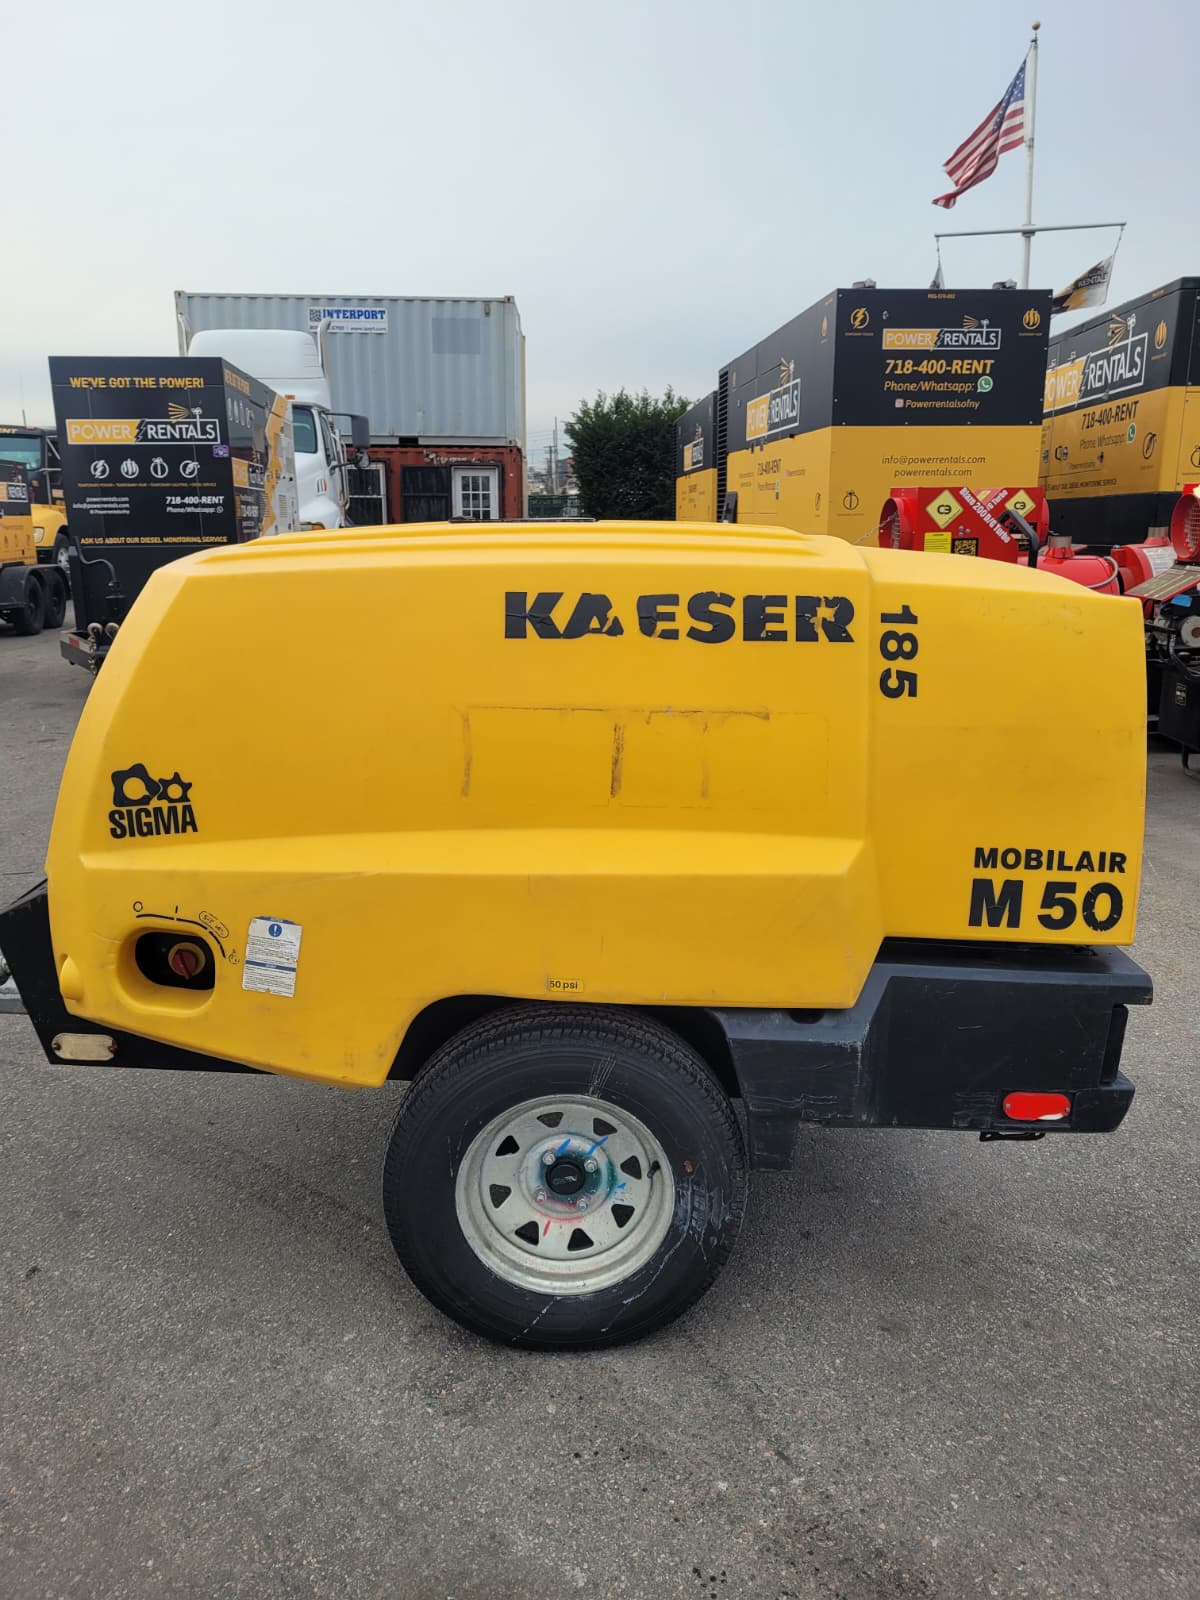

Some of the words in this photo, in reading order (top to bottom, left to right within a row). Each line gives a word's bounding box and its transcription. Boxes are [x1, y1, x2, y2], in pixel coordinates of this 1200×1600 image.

[323, 309, 386, 319] INTERPORT
[886, 334, 932, 345] POWER
[944, 333, 996, 345] RENTALS
[884, 360, 994, 374] 718-400-RENT
[1087, 346, 1141, 390] RENTALS
[70, 377, 106, 388] WE'VE
[109, 377, 131, 388] GOT
[133, 377, 156, 388] THE
[159, 377, 204, 389] POWER!
[884, 381, 975, 393] Phone/Whatsapp:
[770, 389, 798, 425] RENTALS
[905, 399, 980, 410] Powerrentalsofny
[1081, 400, 1139, 430] 718-400-RENT
[71, 424, 132, 439] POWER
[147, 424, 215, 439] RENTALS
[882, 455, 986, 465] info@powerrentals.com
[894, 467, 972, 478] powerrentals.com
[165, 495, 224, 505] 718-400-RENT
[973, 502, 989, 517] 200
[105, 536, 125, 544] ABOUT
[140, 536, 163, 544] DIESEL
[504, 590, 855, 644] KAESER
[879, 604, 919, 699] 185
[108, 804, 198, 839] SIGMA
[973, 847, 1127, 874] MOBILAIR
[968, 878, 1024, 929] M
[1037, 881, 1124, 932] 50
[563, 980, 578, 991] psi
